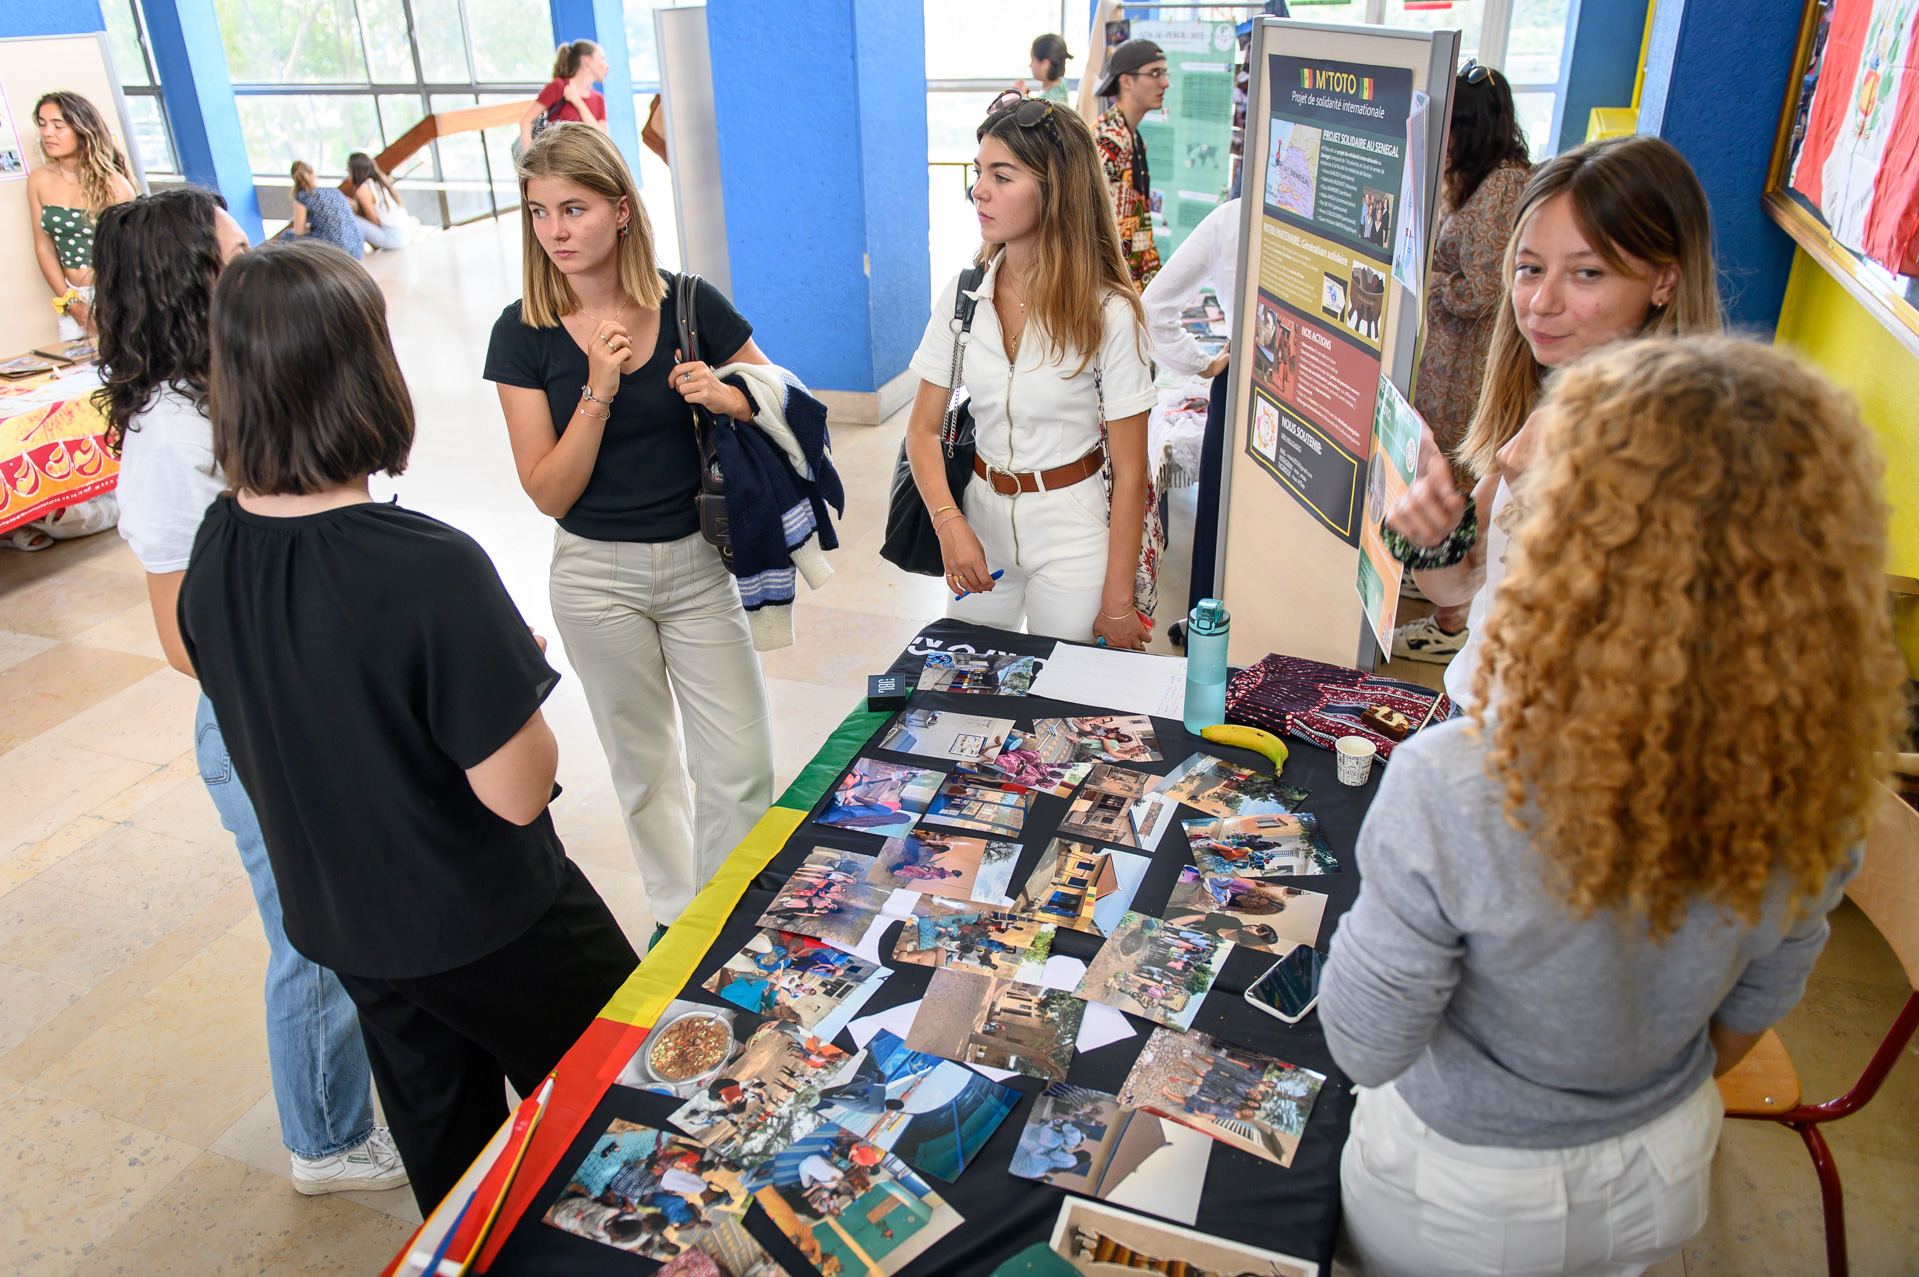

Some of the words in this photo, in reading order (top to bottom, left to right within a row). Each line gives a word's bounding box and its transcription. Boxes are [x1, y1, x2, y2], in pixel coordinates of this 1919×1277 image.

[1316, 70, 1357, 94] M'TOTO
[1292, 91, 1307, 106] Projet
[1308, 94, 1315, 105] de
[1316, 95, 1341, 110] solidarité
[1342, 100, 1385, 118] internationale
[1323, 130, 1341, 142] PROJET
[1341, 134, 1366, 149] SOLIDAIRE
[1367, 140, 1374, 151] AU
[1375, 141, 1399, 157] SENEGAL
[1290, 170, 1310, 187] SENEGAL
[1302, 238, 1327, 256] Génération
[1327, 250, 1348, 266] solidaire
[1301, 326, 1312, 340] NOS
[1312, 333, 1332, 351] ACTIONS
[1281, 416, 1296, 435] NOUS
[877, 678, 896, 694] JBL
